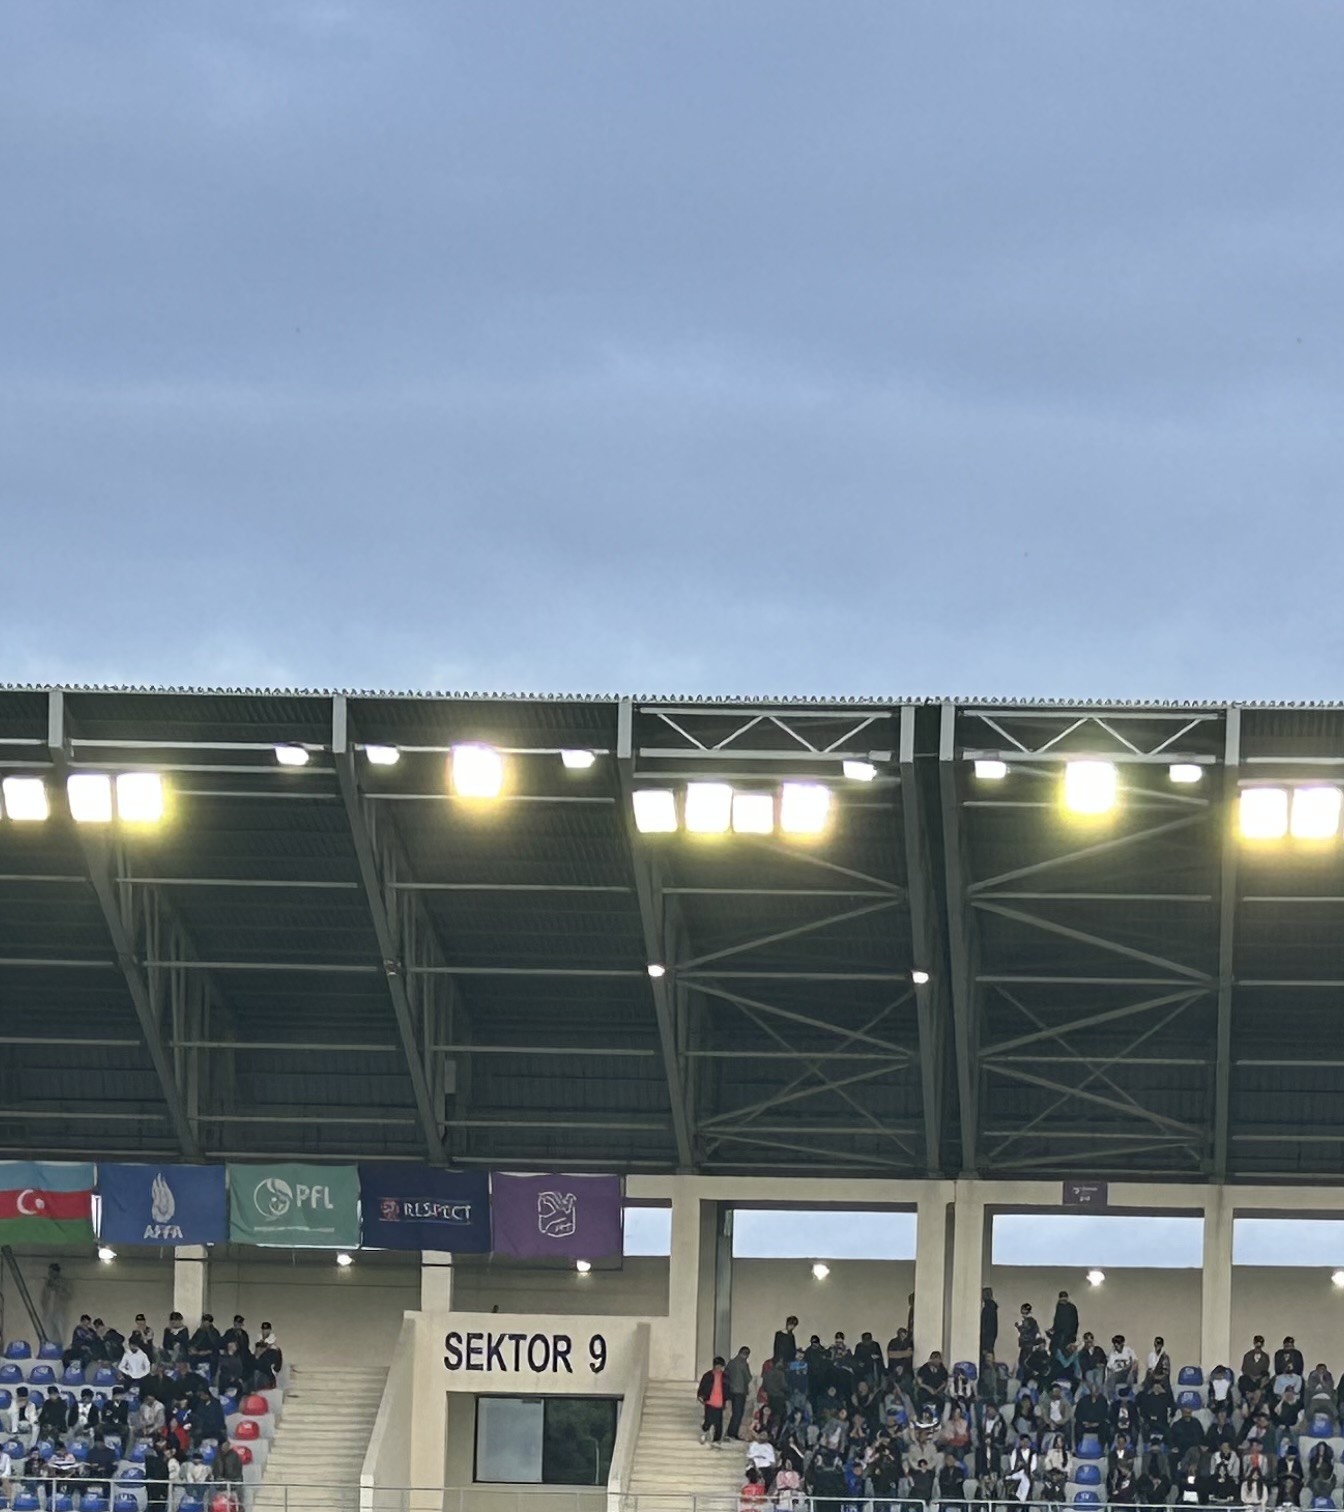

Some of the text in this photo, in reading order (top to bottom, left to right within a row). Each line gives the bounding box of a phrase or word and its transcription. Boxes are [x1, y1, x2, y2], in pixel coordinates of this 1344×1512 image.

[296, 1184, 334, 1209] PFL
[443, 1331, 607, 1374] SEKTOR 9
